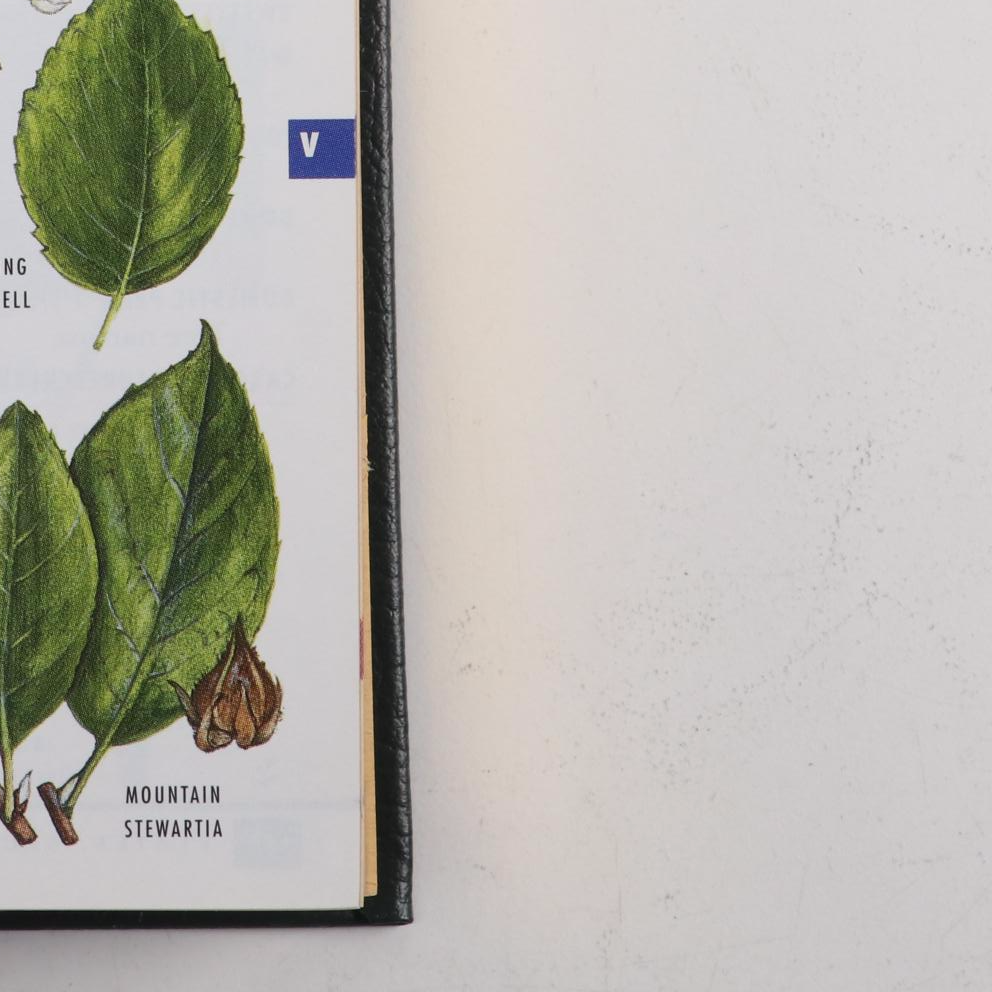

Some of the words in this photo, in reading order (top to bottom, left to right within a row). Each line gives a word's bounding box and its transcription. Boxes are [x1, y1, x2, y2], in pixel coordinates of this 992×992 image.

[300, 131, 320, 158] V
[125, 785, 221, 805] MOUNTAIN
[124, 819, 223, 839] STEWARTIA
